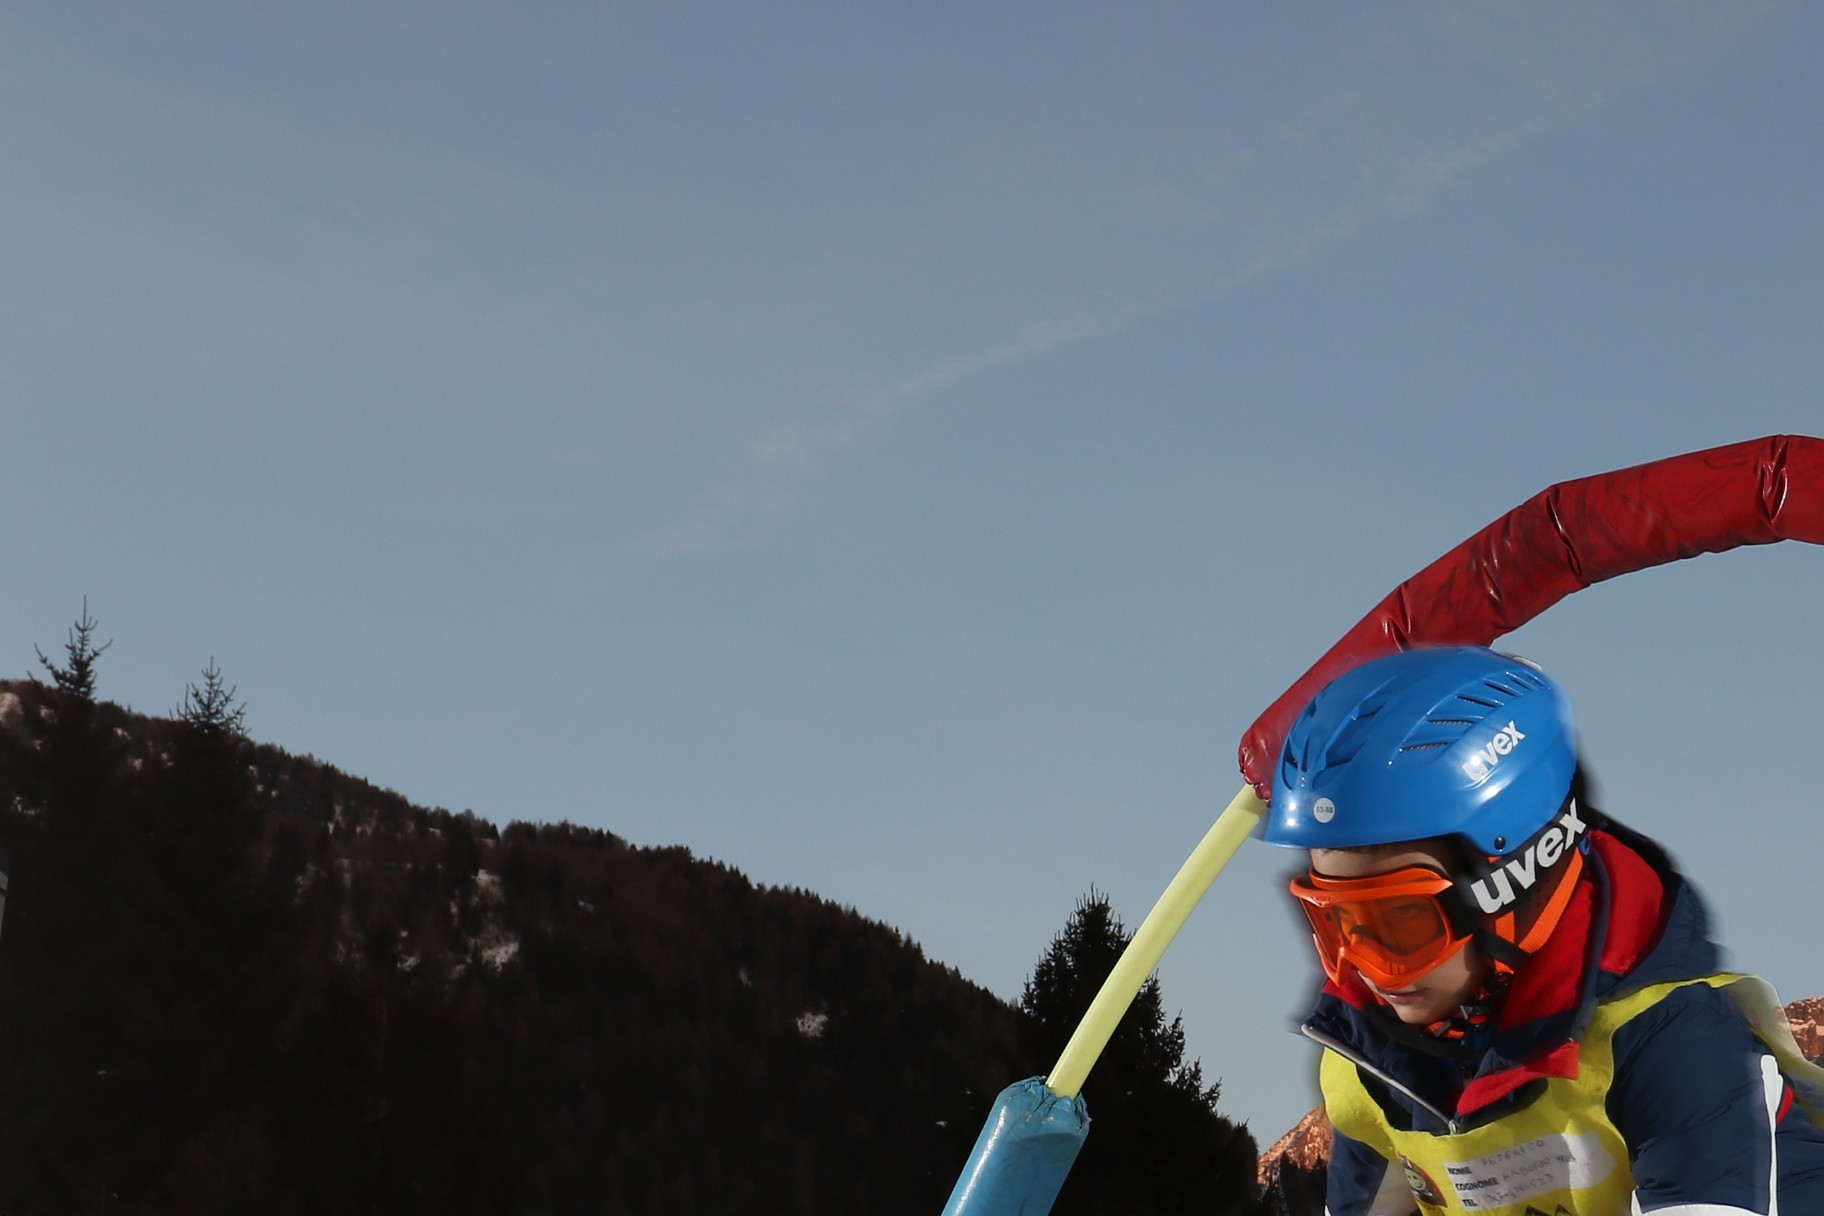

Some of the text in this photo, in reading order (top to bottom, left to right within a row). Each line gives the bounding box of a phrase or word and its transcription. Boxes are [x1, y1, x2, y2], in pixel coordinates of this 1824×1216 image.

[1462, 720, 1527, 782] uvex
[1470, 797, 1587, 915] uvex
[1447, 1166, 1473, 1175] NOME
[1455, 1177, 1499, 1192] COGNOME
[1462, 1199, 1478, 1207] TEL
